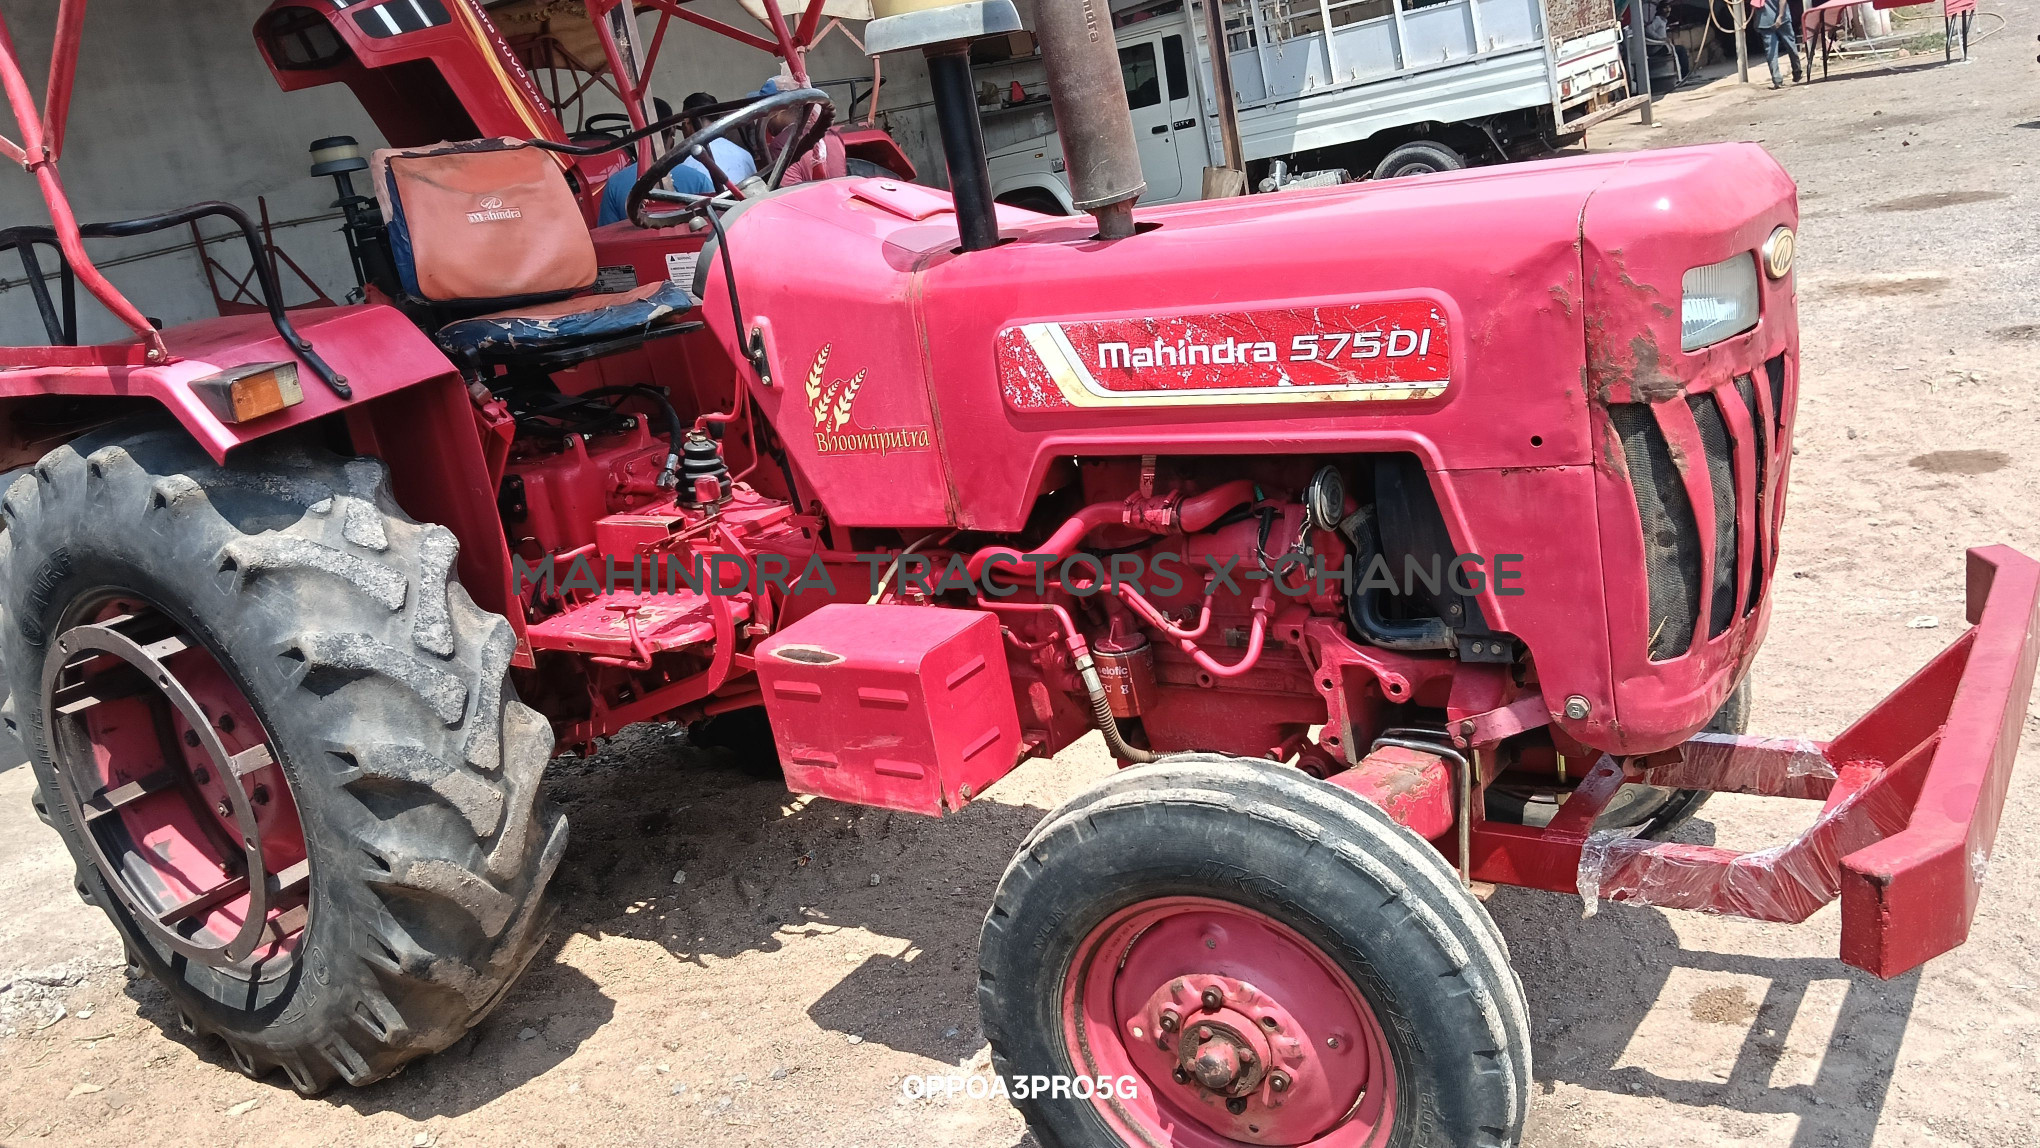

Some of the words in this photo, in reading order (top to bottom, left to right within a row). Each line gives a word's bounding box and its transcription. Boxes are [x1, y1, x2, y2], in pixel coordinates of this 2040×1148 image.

[470, 0, 495, 33] ndra
[498, 37, 525, 78] YUVO
[1174, 120, 1190, 128] CITY
[1097, 335, 1278, 369] Mahindra
[815, 428, 931, 458] Bhoomiputra
[1101, 665, 1128, 676] elofic
[1033, 904, 1066, 951] NYLON
